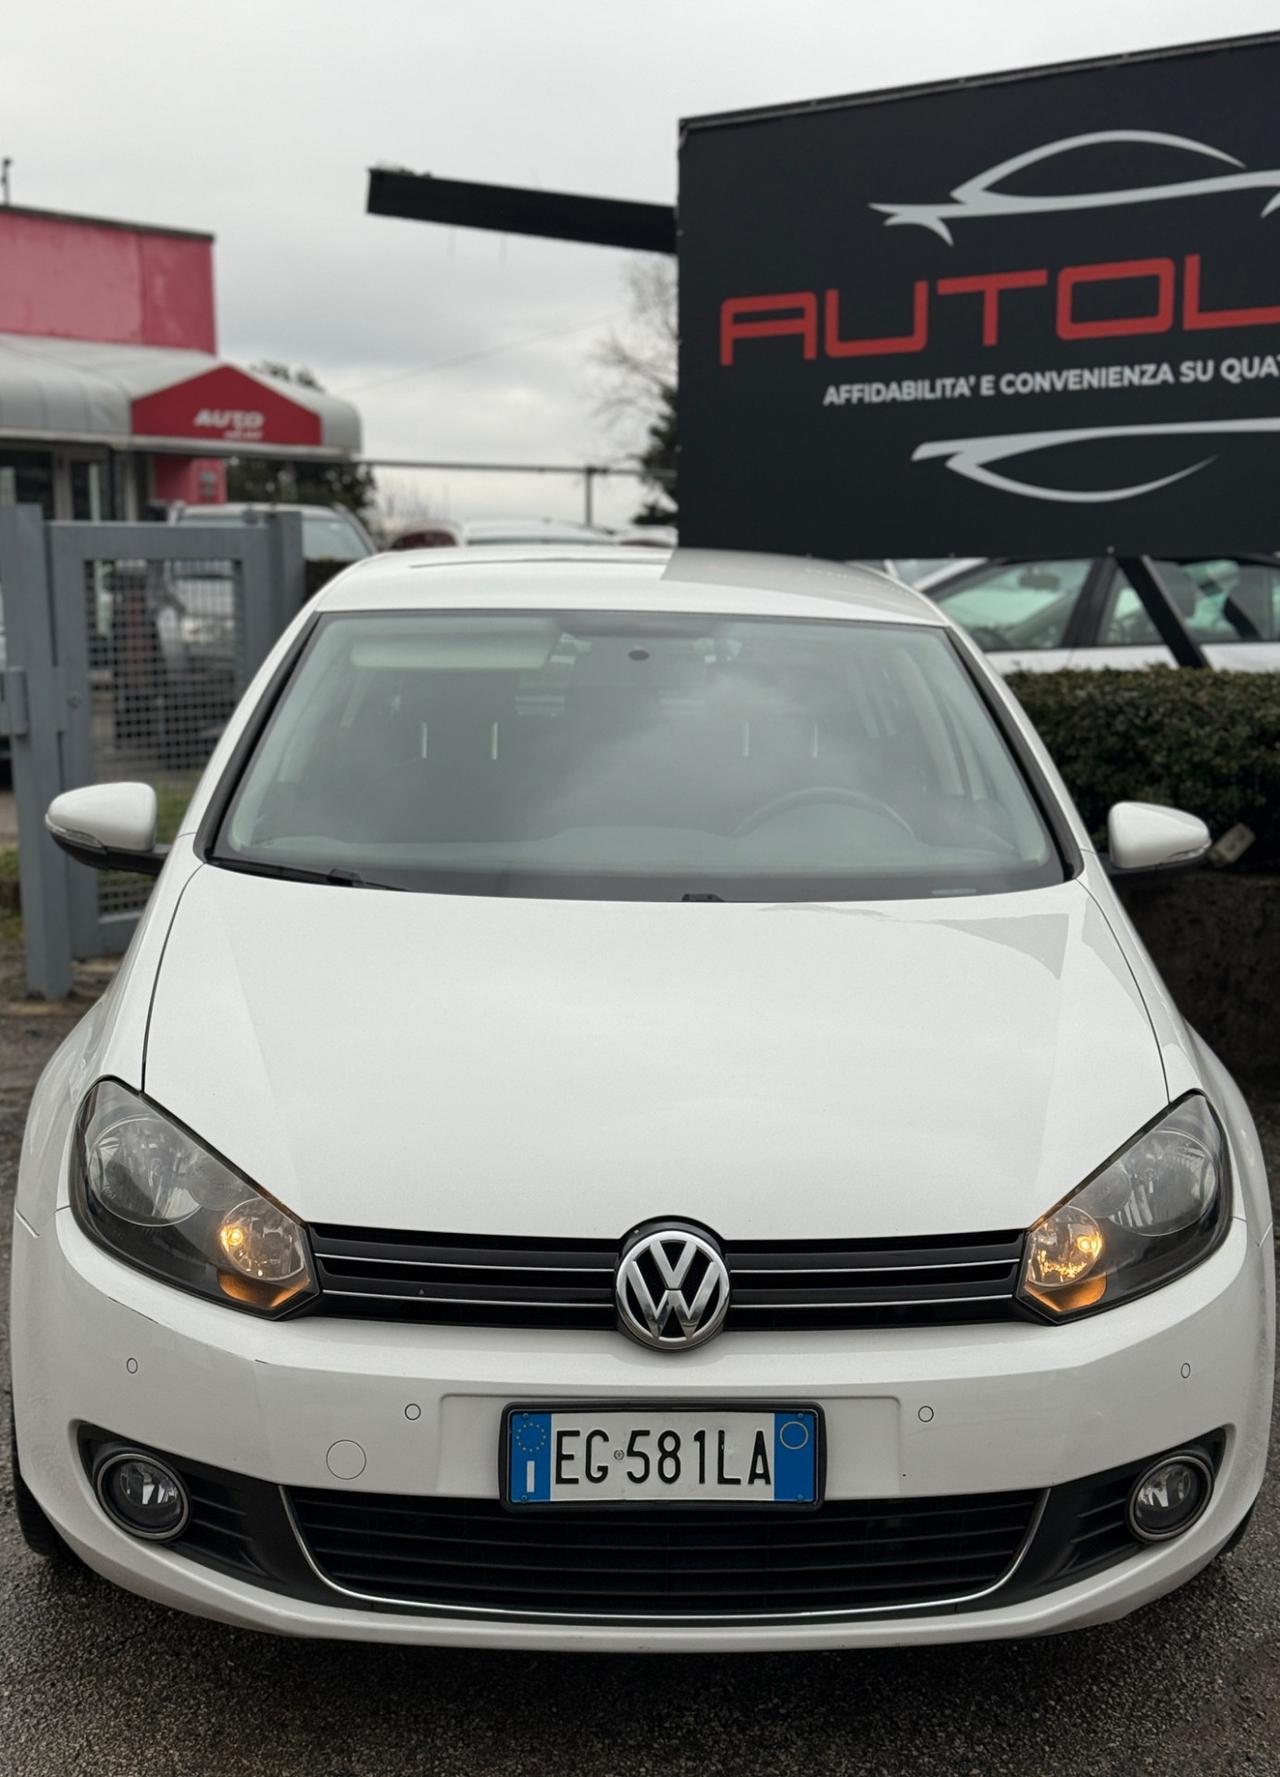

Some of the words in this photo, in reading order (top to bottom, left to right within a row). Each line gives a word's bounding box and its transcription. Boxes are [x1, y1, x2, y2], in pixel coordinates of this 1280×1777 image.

[823, 375, 976, 406] AFFIDABILITA'
[980, 374, 996, 396] E
[999, 362, 1175, 395] CONVENIENZA
[1179, 359, 1215, 384] SU
